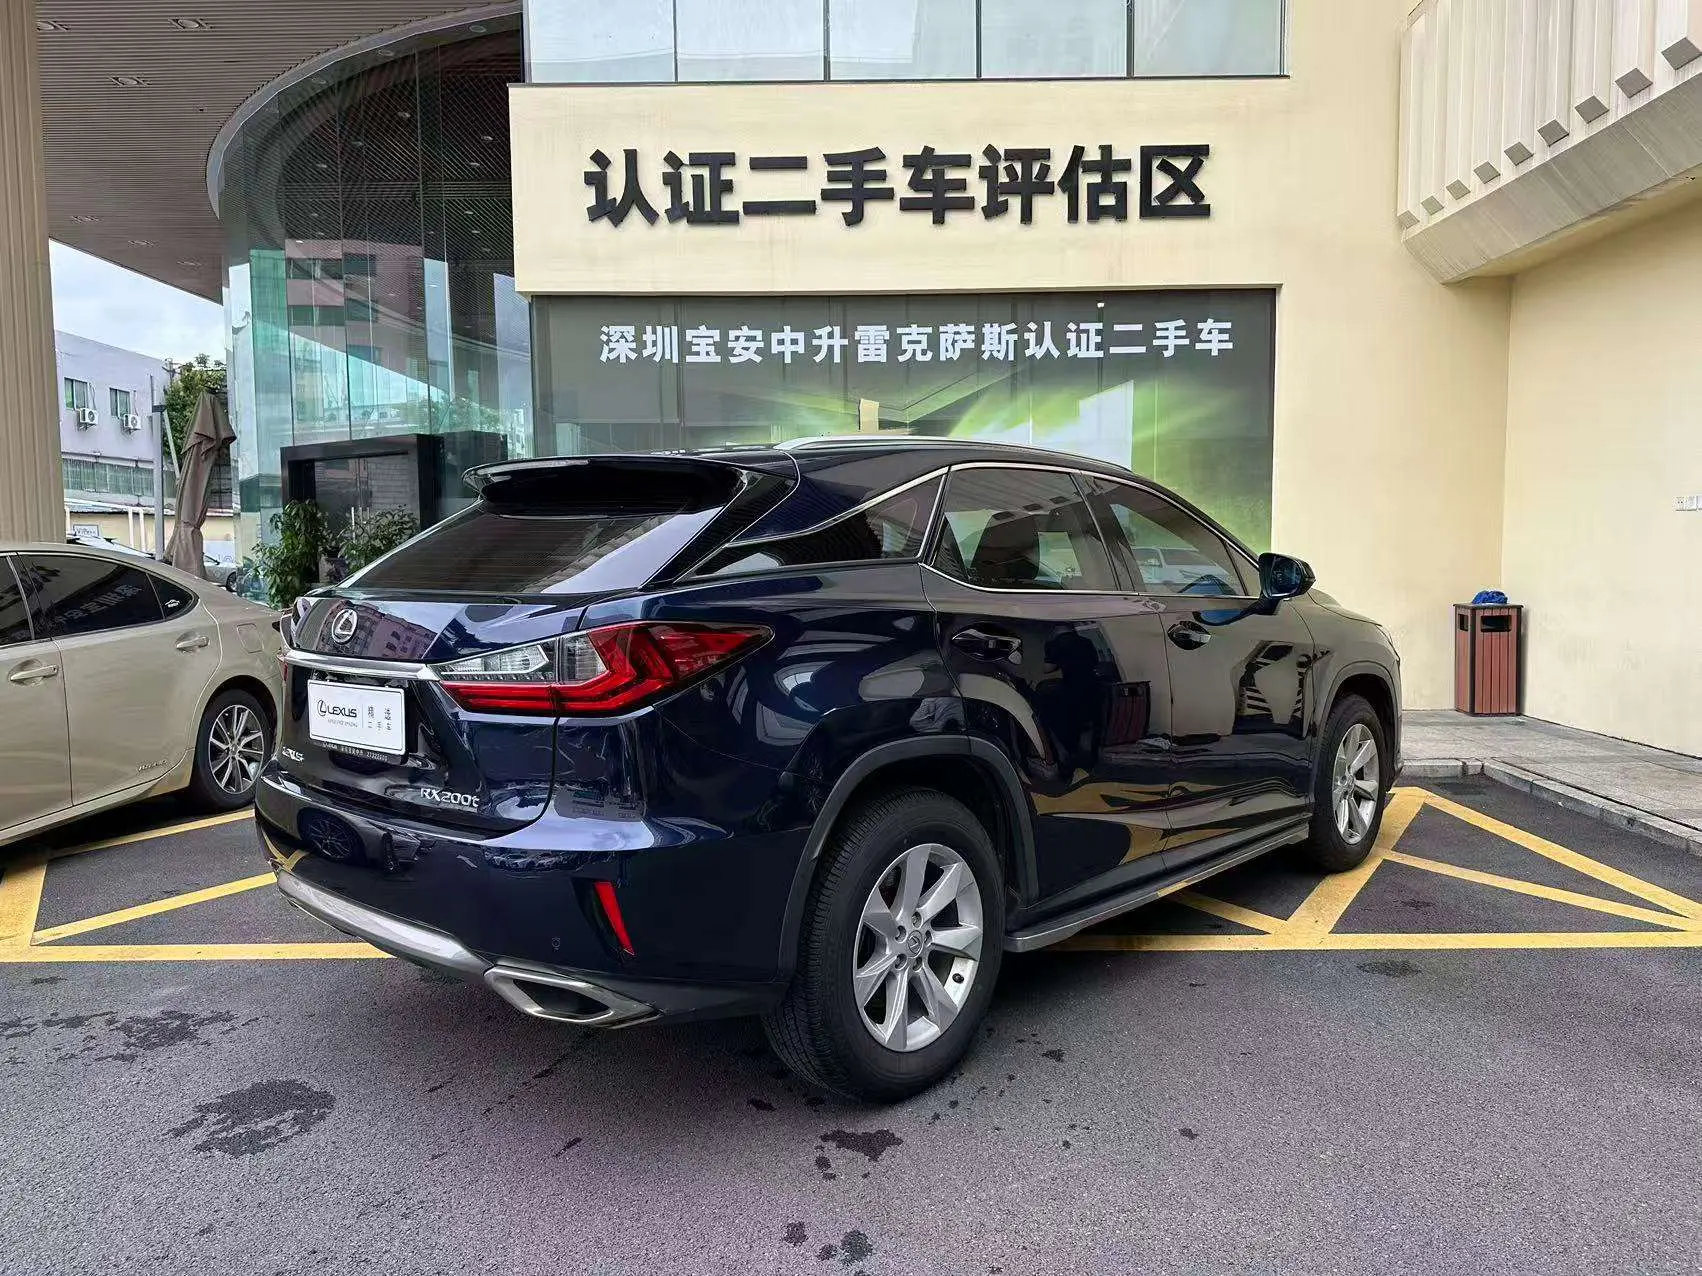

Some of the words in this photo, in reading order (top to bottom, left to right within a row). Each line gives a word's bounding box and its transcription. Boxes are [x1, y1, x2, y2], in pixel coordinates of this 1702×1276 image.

[584, 144, 1211, 226] 认证二手车评估区
[599, 319, 1233, 364] 深圳宝安中升雷克萨斯认证二手车
[327, 704, 357, 718] LEXUS
[420, 787, 480, 808] RX200t
